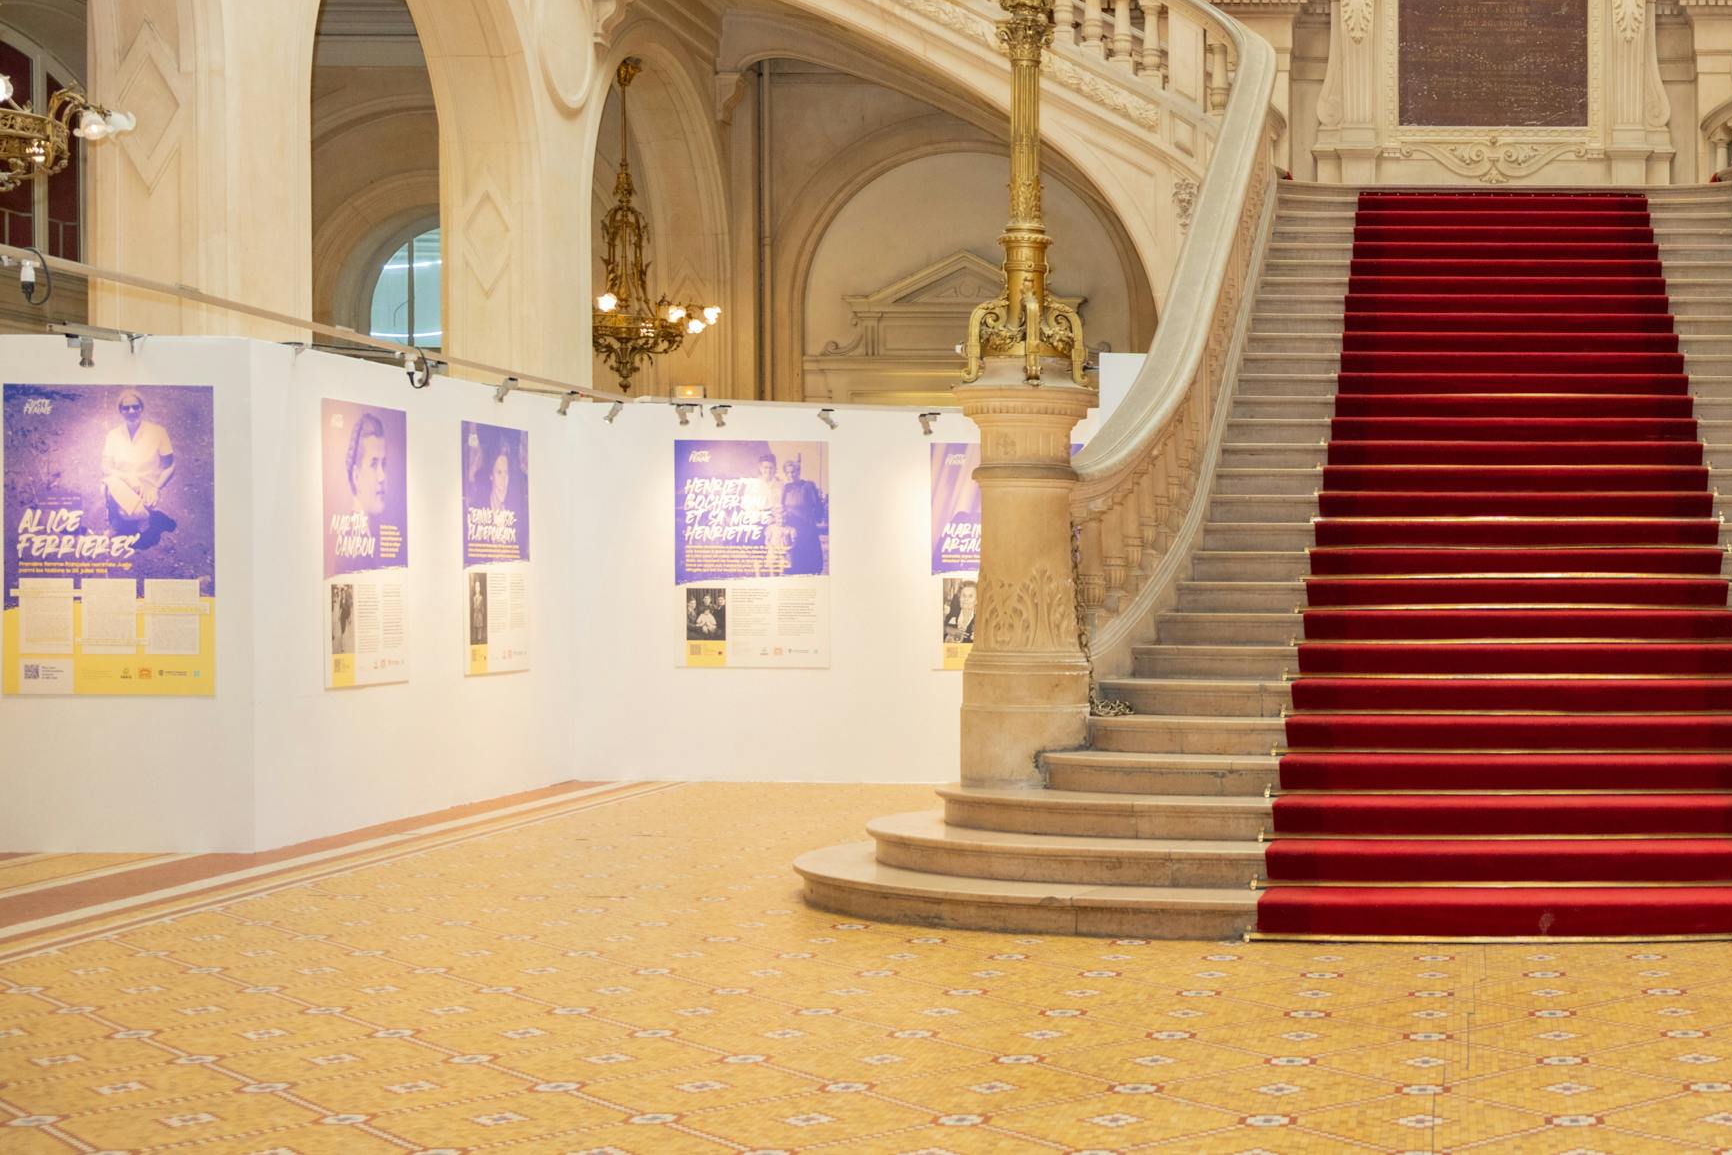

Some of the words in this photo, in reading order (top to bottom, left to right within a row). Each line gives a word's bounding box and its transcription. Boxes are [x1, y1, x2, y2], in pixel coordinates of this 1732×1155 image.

[18, 507, 84, 534] ALICE
[329, 510, 369, 536] MARTHE
[335, 534, 376, 559] CAMBOU
[684, 525, 763, 544] HENRIETTE
